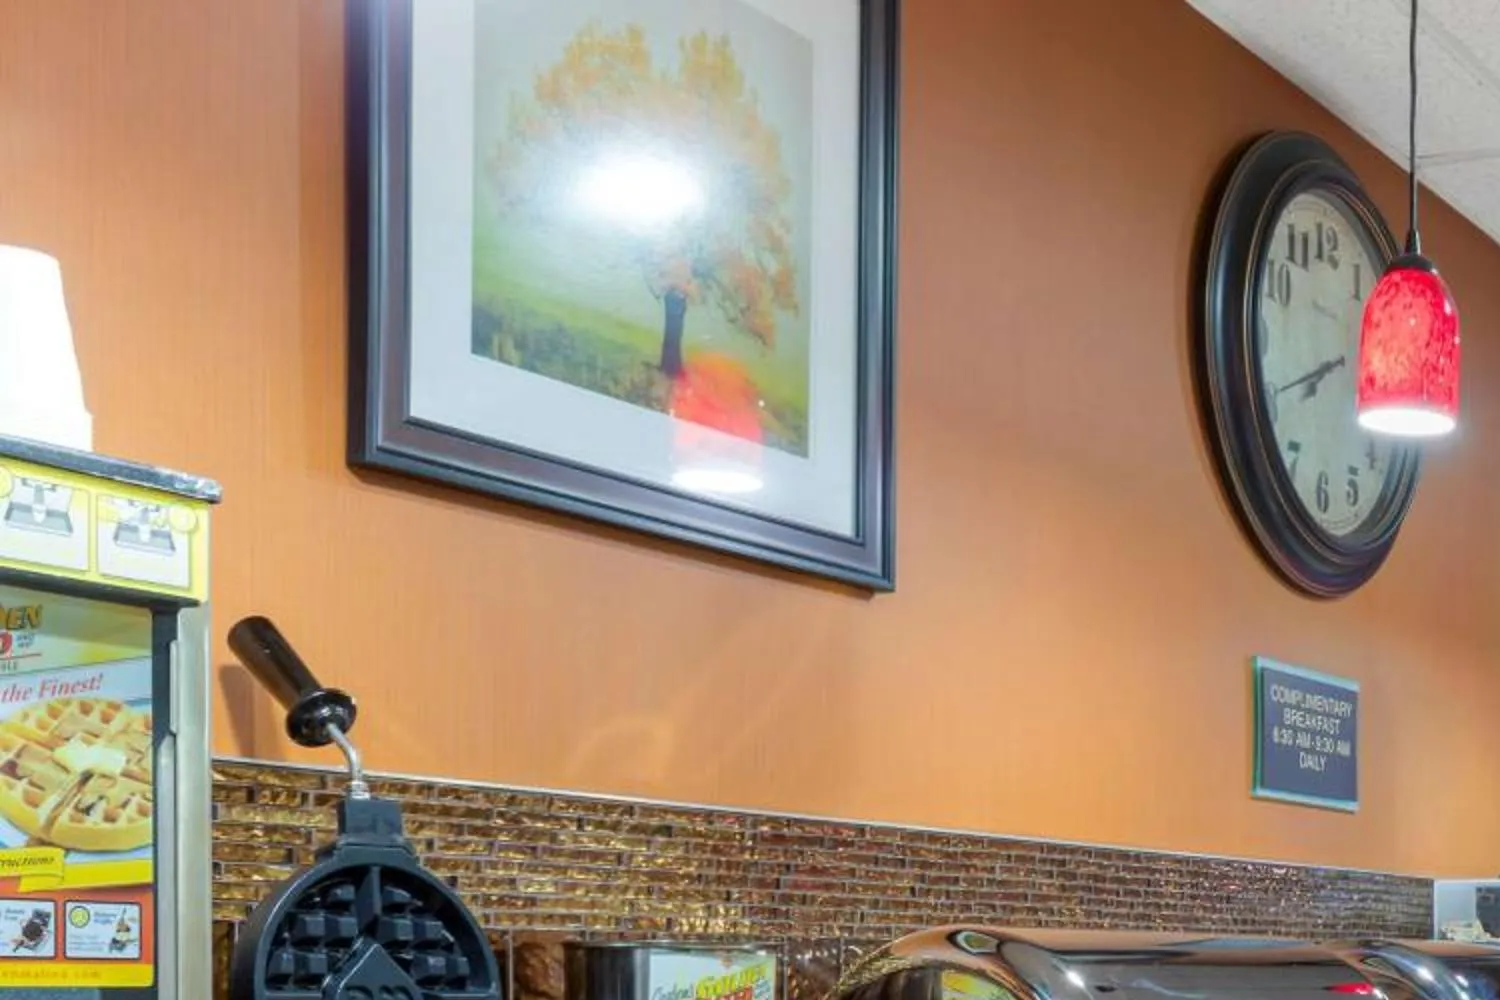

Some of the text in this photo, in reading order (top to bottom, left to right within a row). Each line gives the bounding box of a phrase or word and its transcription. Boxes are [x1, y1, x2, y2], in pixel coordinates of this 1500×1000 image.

[1286, 223, 1309, 272] 11
[1315, 221, 1340, 271] 12
[1265, 258, 1291, 308] 10
[1316, 470, 1330, 514] 6
[1346, 465, 1360, 507] 5
[1270, 684, 1353, 718] COMPLIMENTARY
[1283, 708, 1341, 735] BREAKFAST
[1299, 751, 1327, 772] DAILY
